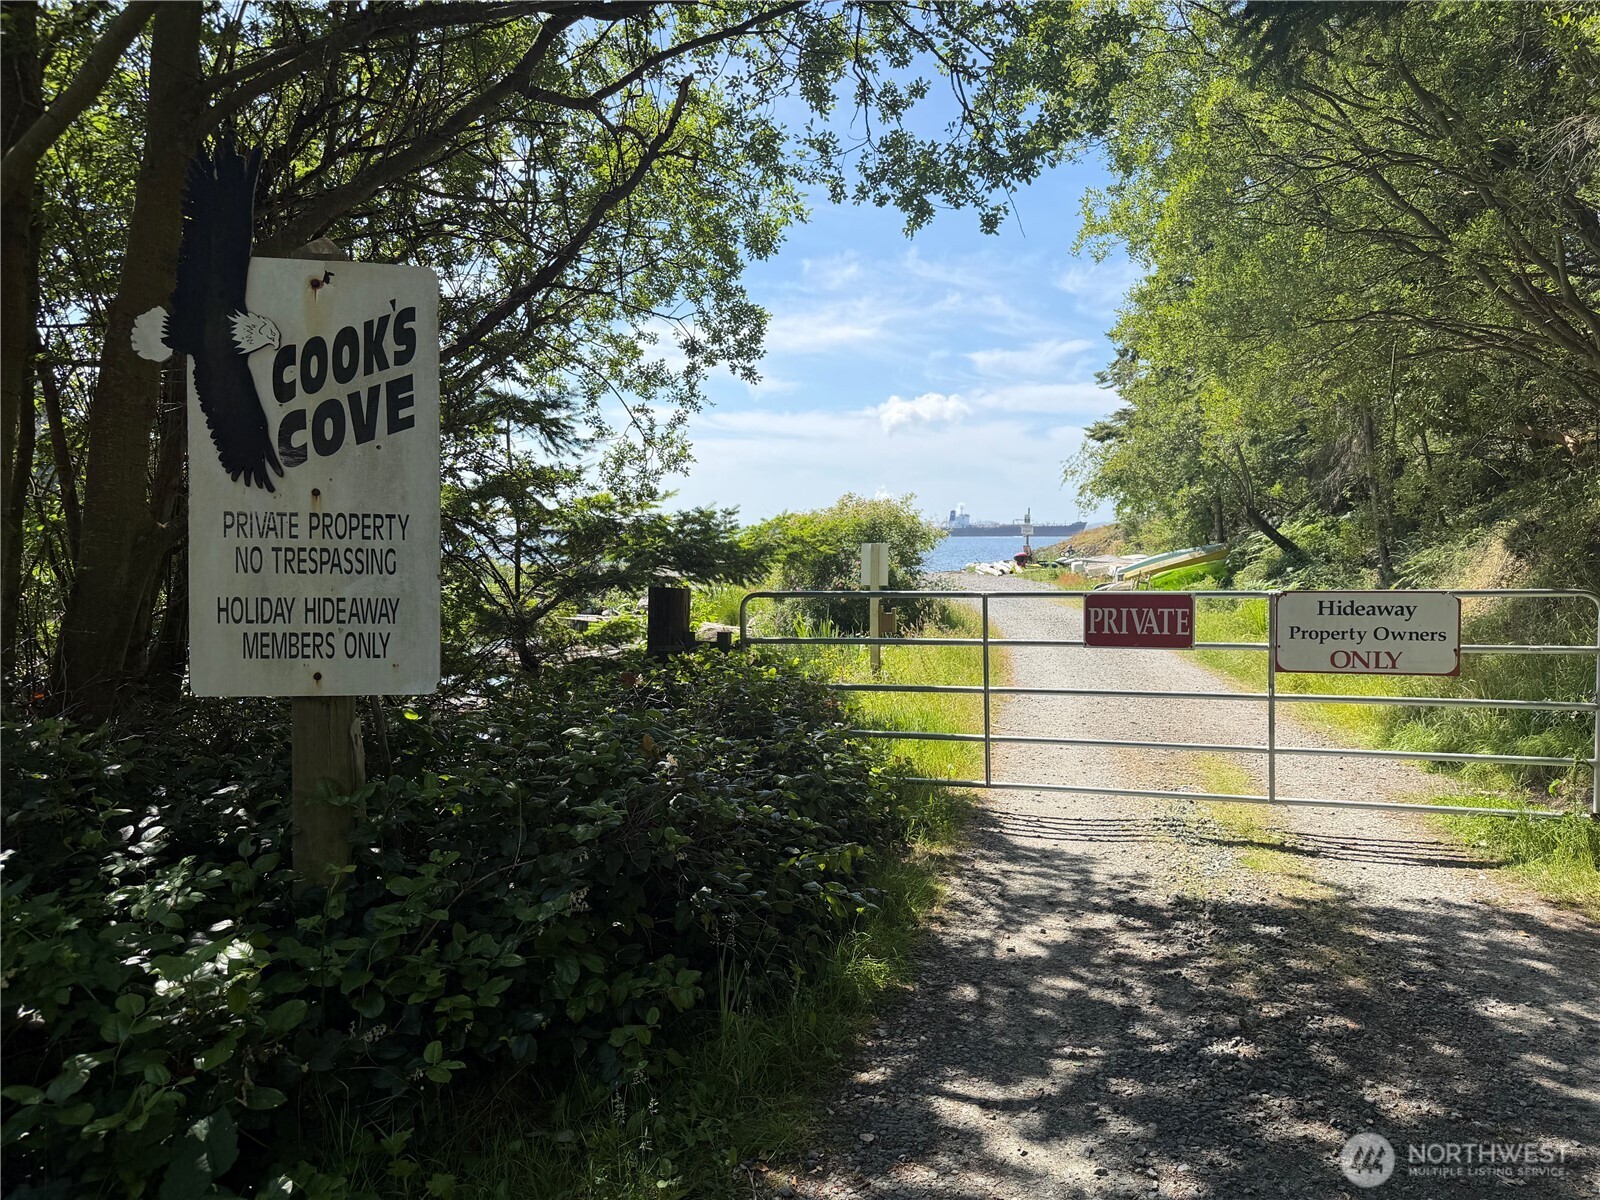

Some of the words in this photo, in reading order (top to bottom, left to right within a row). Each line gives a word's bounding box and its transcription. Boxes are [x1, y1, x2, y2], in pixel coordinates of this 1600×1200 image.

[272, 299, 417, 403] COOK'S
[277, 374, 416, 468] COVE
[223, 511, 299, 539] PRIVATE
[308, 513, 410, 541] PROPERTY
[235, 546, 263, 574] NO
[271, 547, 398, 575] TRESPASSING
[217, 597, 296, 624] HOLIDAY
[304, 597, 400, 624] HIDEAWAY
[1087, 607, 1190, 636] PRIVATE
[1317, 600, 1418, 621] Hideaway
[242, 632, 336, 659] MEMBERS
[344, 632, 391, 659] ONLY
[1288, 626, 1367, 645] Property
[1373, 626, 1447, 642] Owners
[1329, 650, 1402, 670] ONLY
